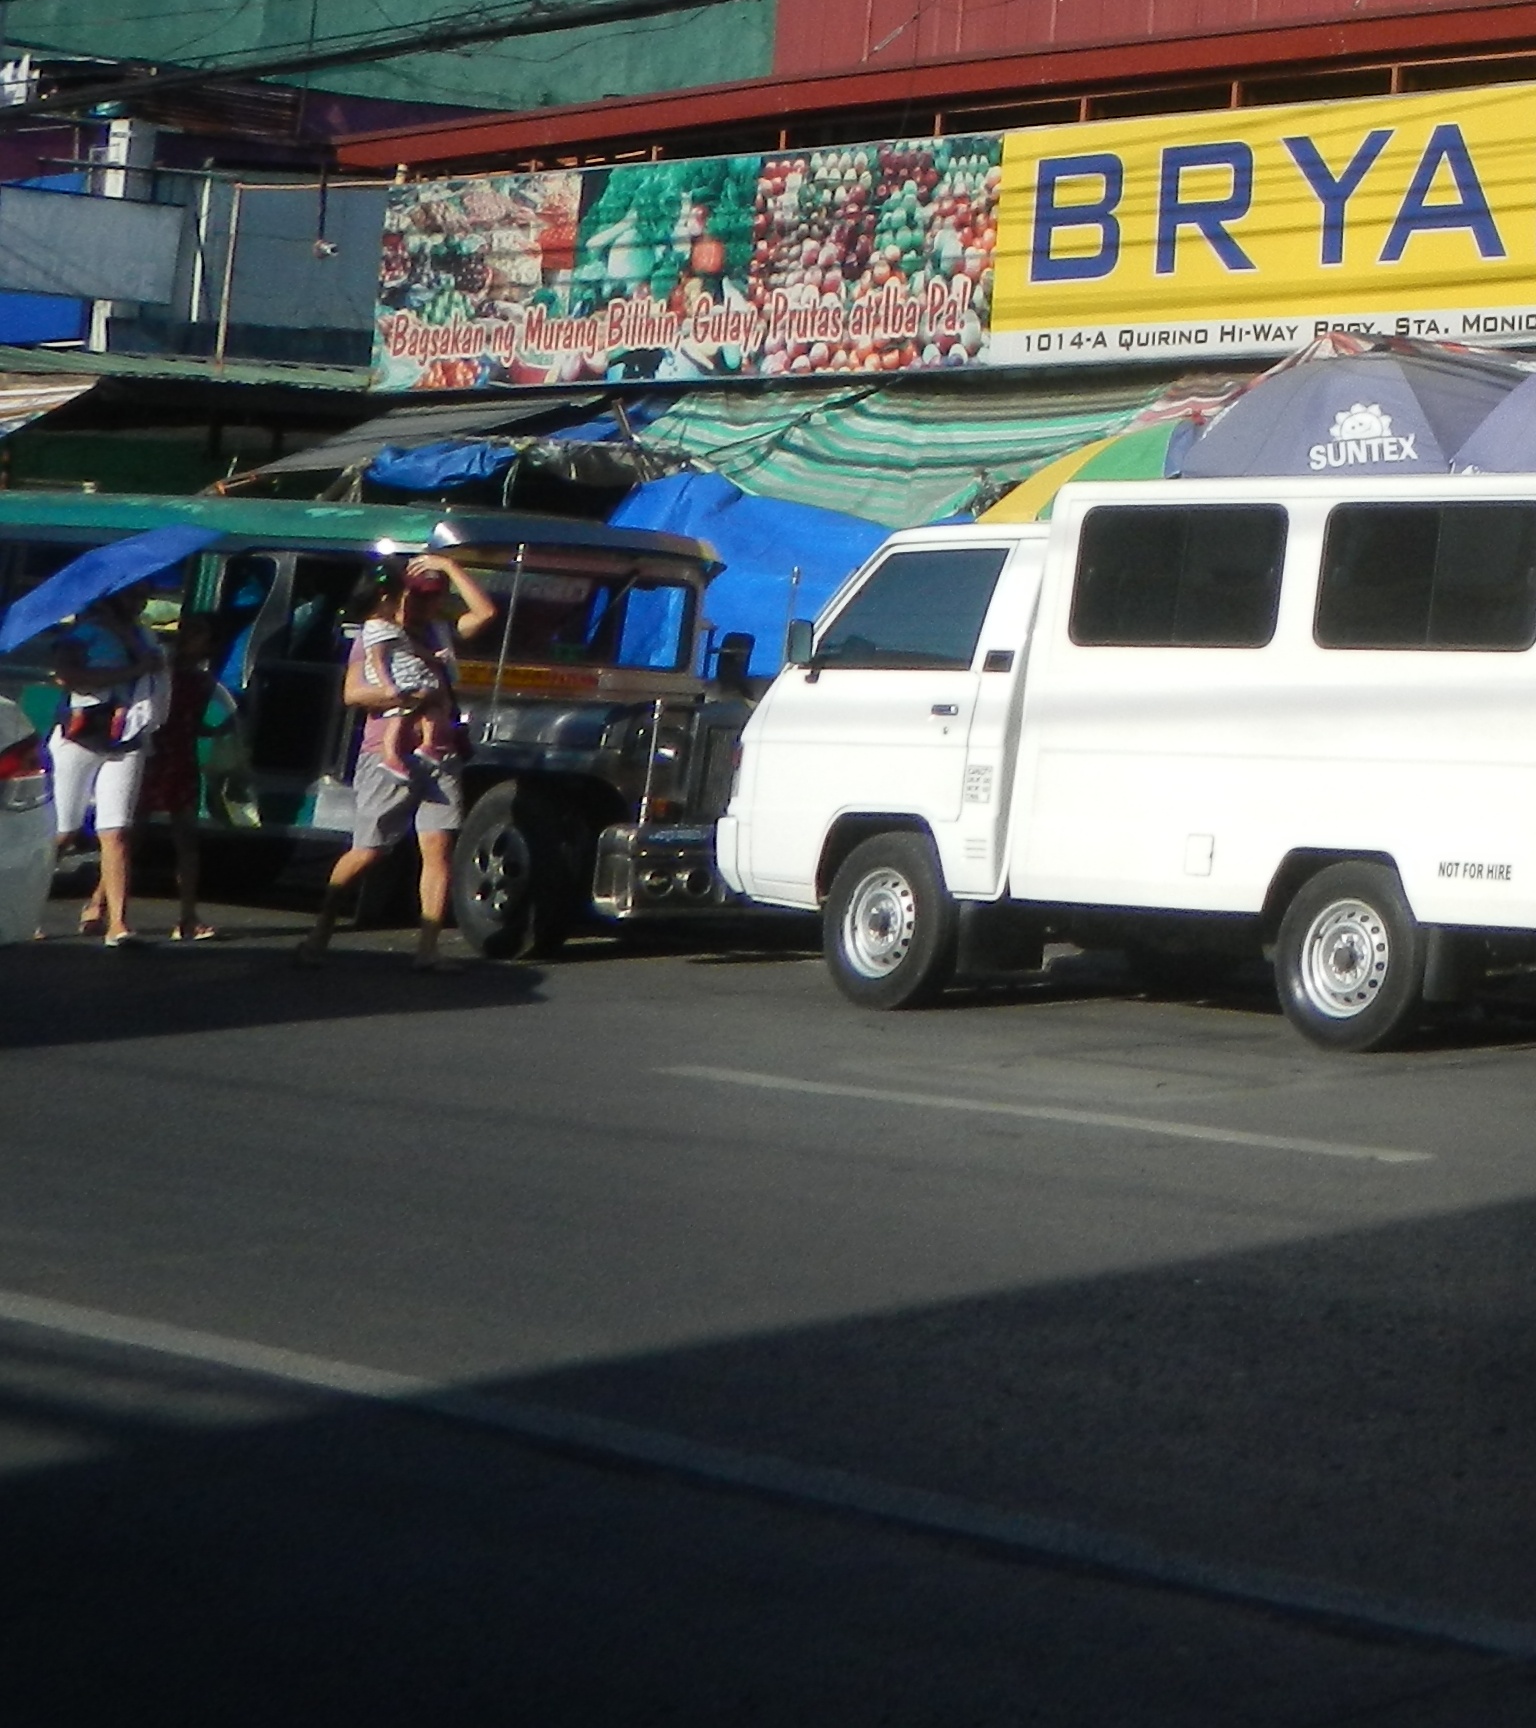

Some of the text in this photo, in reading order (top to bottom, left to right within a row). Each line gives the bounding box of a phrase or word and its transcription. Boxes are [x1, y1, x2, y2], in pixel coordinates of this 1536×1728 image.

[392, 275, 968, 366] Bagsakan ng Murang Bilihin, Gulay, Prutas at Iba Pa!
[1025, 329, 1108, 352] 1014-A
[1119, 328, 1208, 349] QUIRINO
[1220, 324, 1299, 343] HI-WAY
[1395, 316, 1449, 336] STA.
[1309, 432, 1419, 472] SUNTEX
[1438, 861, 1512, 881] NOT FOR HIRE
